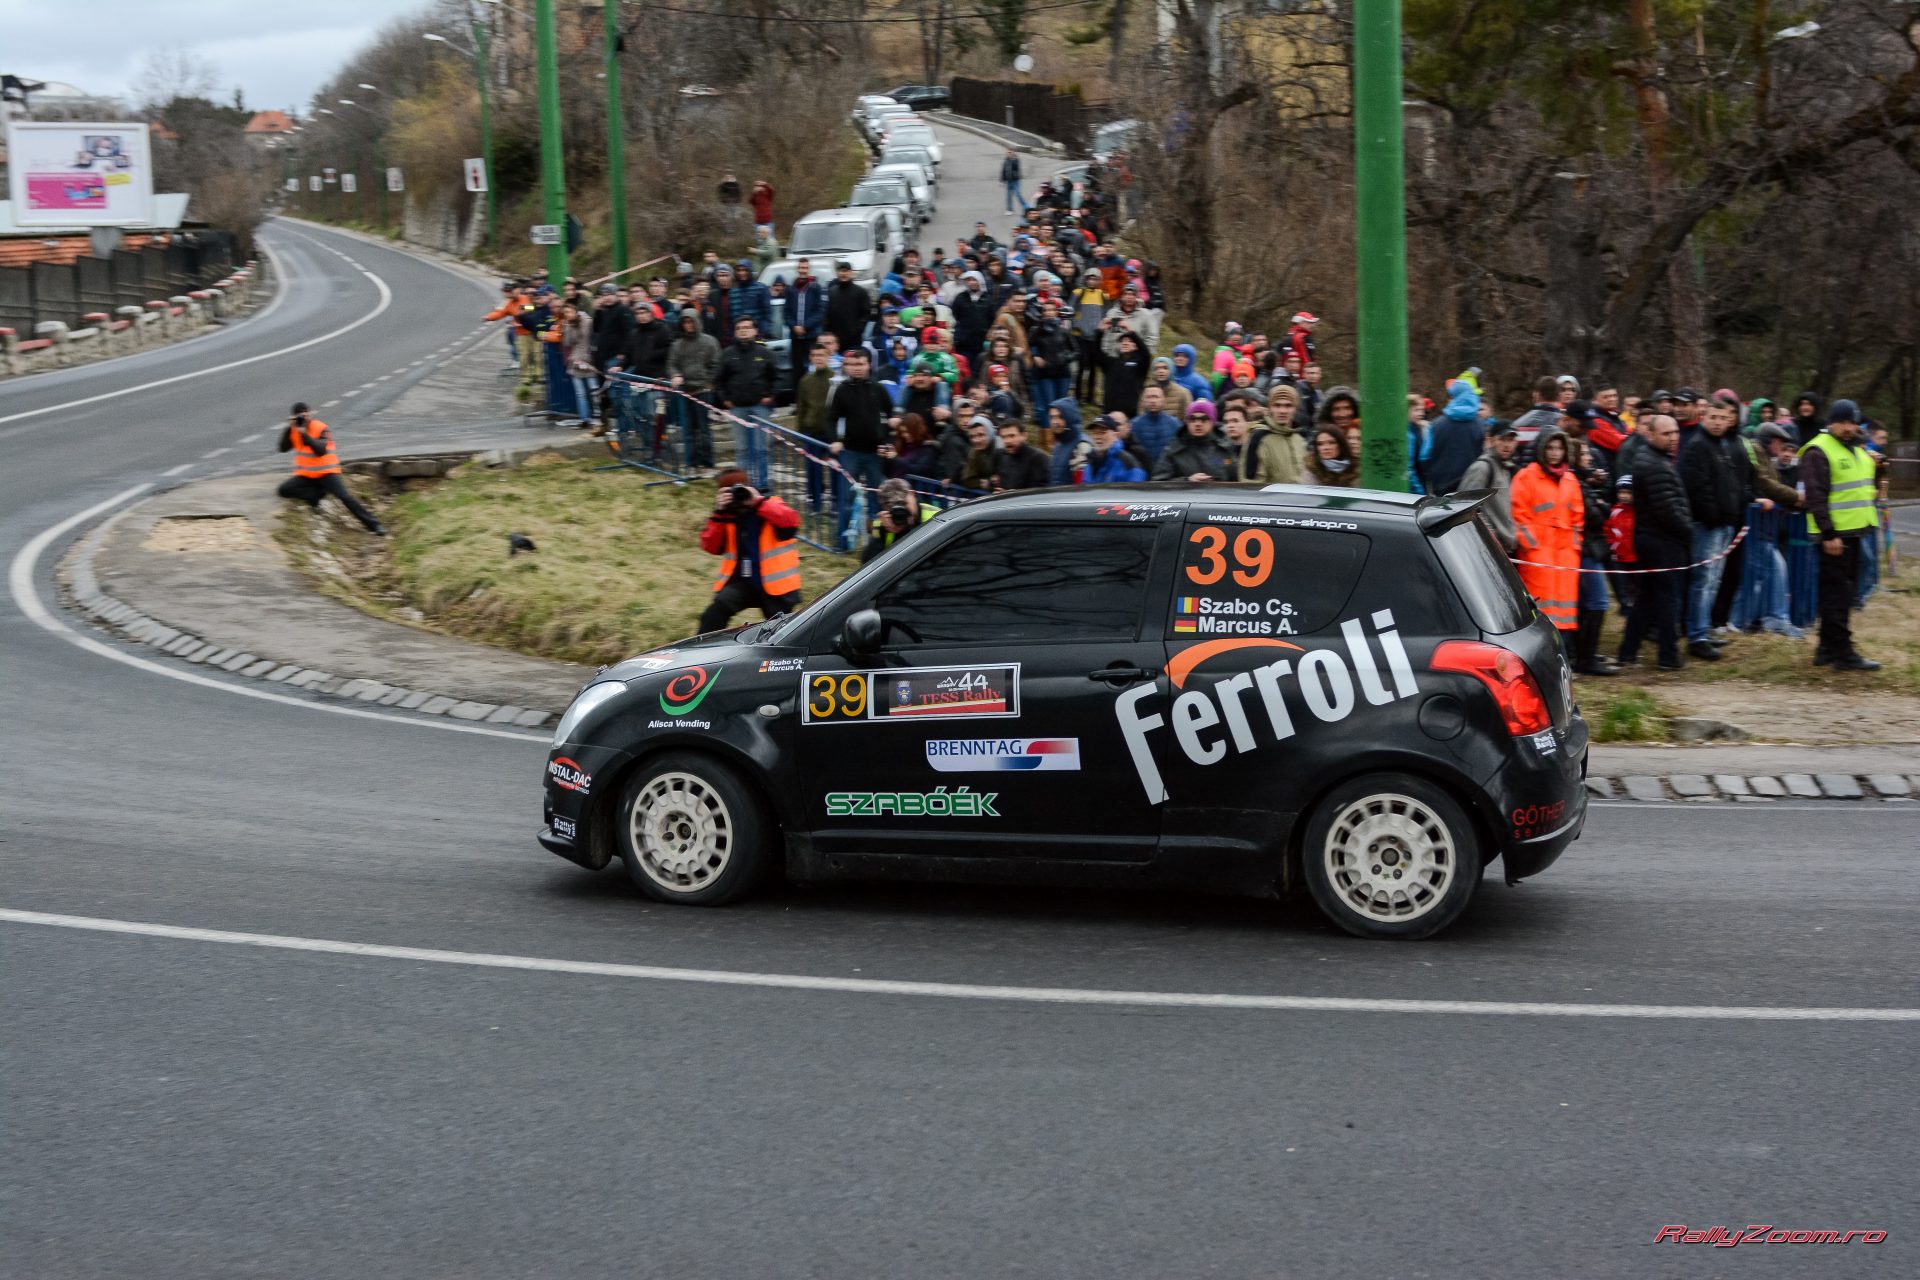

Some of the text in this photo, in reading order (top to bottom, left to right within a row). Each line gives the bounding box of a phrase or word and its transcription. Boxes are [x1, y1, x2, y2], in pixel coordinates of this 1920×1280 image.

[1129, 512, 1148, 521] Rally
[1208, 514, 1358, 530] www.sparco-shop.ro
[1185, 526, 1275, 588] 39
[1199, 597, 1298, 616] Szabo Cs.
[1199, 616, 1298, 635] Marcus A.
[958, 671, 989, 691] 44
[809, 674, 867, 718] 39
[920, 687, 1001, 705] TESS Rally
[648, 719, 711, 730] Alisca Vending
[927, 739, 1023, 756] BRENNTAG
[548, 760, 592, 788] NSTAL-DAC
[825, 786, 1002, 817] SZABÓÉK
